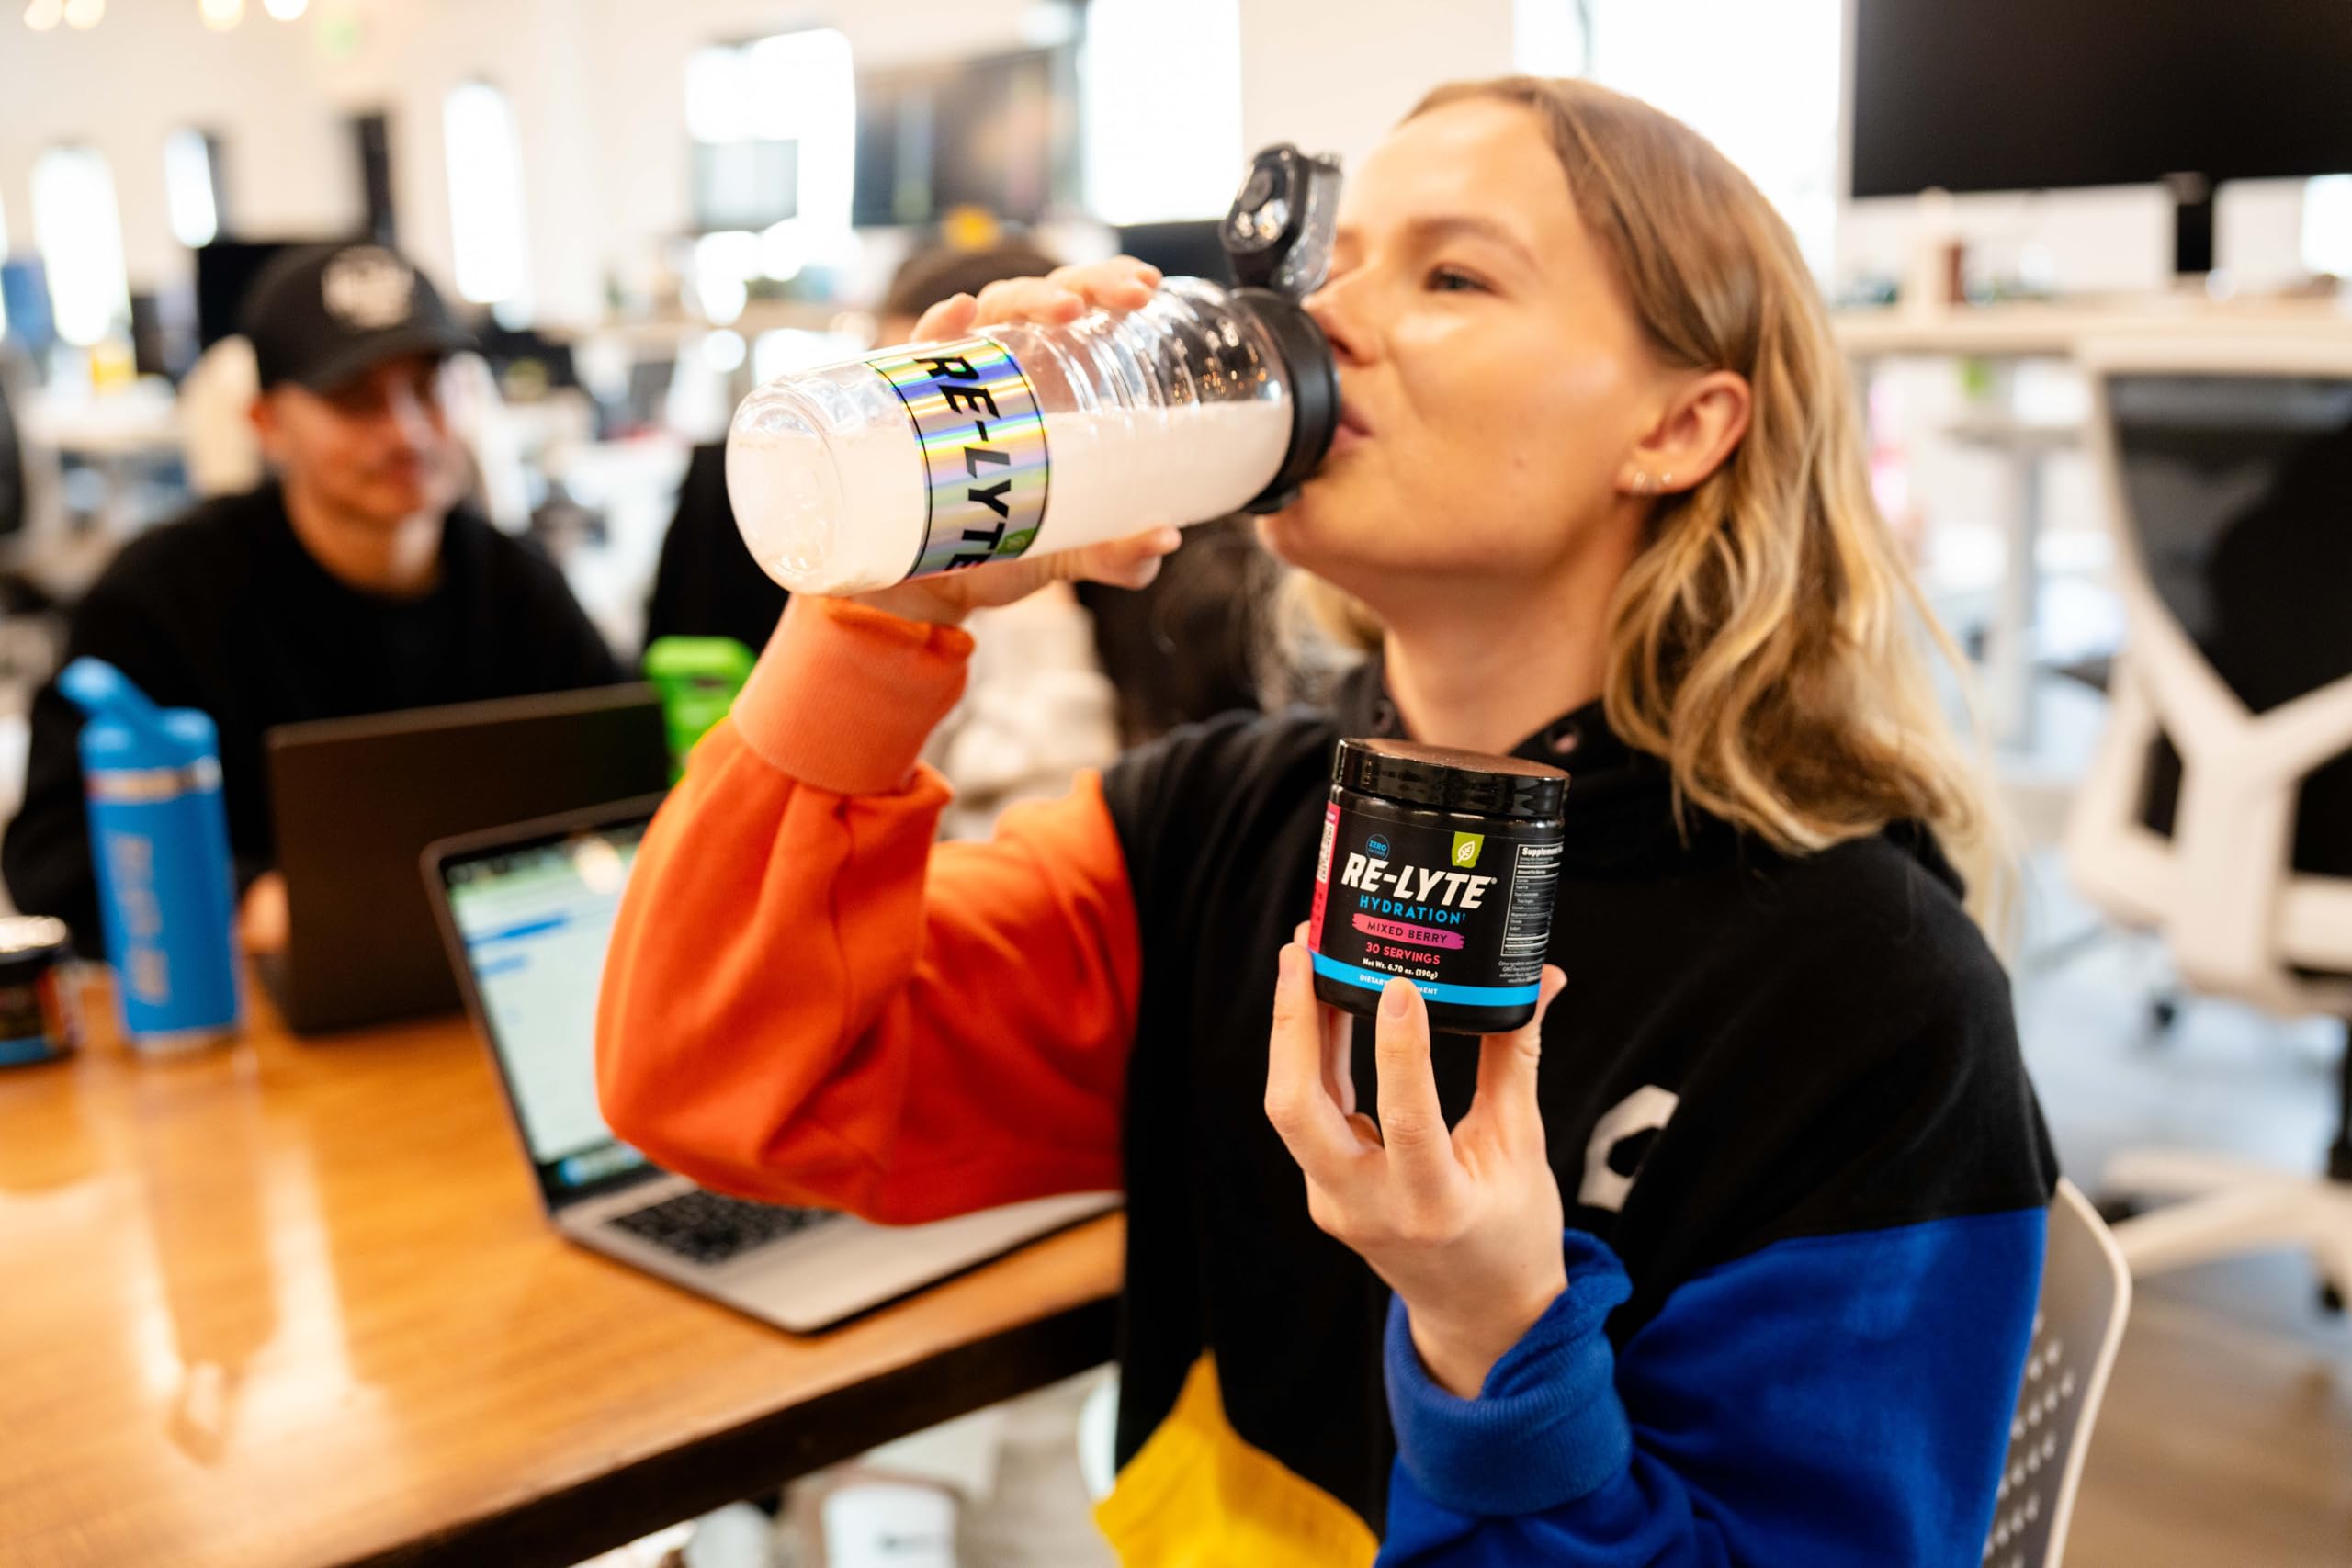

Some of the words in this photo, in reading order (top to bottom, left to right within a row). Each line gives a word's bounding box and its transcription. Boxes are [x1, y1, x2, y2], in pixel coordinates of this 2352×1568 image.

[913, 355, 1012, 571] RE-LYTE
[1369, 840, 1387, 852] ZERO
[1341, 852, 1492, 909] RE-LYTE
[1360, 894, 1461, 925] HYDRATION
[1367, 921, 1404, 936] MIXED
[1408, 930, 1448, 943] BERRY
[1366, 942, 1380, 954] 30
[1383, 946, 1441, 965] SERVINGS
[1363, 958, 1374, 966] Net
[1375, 961, 1386, 969] Wt.
[1387, 963, 1404, 973] 6.70
[1415, 969, 1438, 980] (190g)
